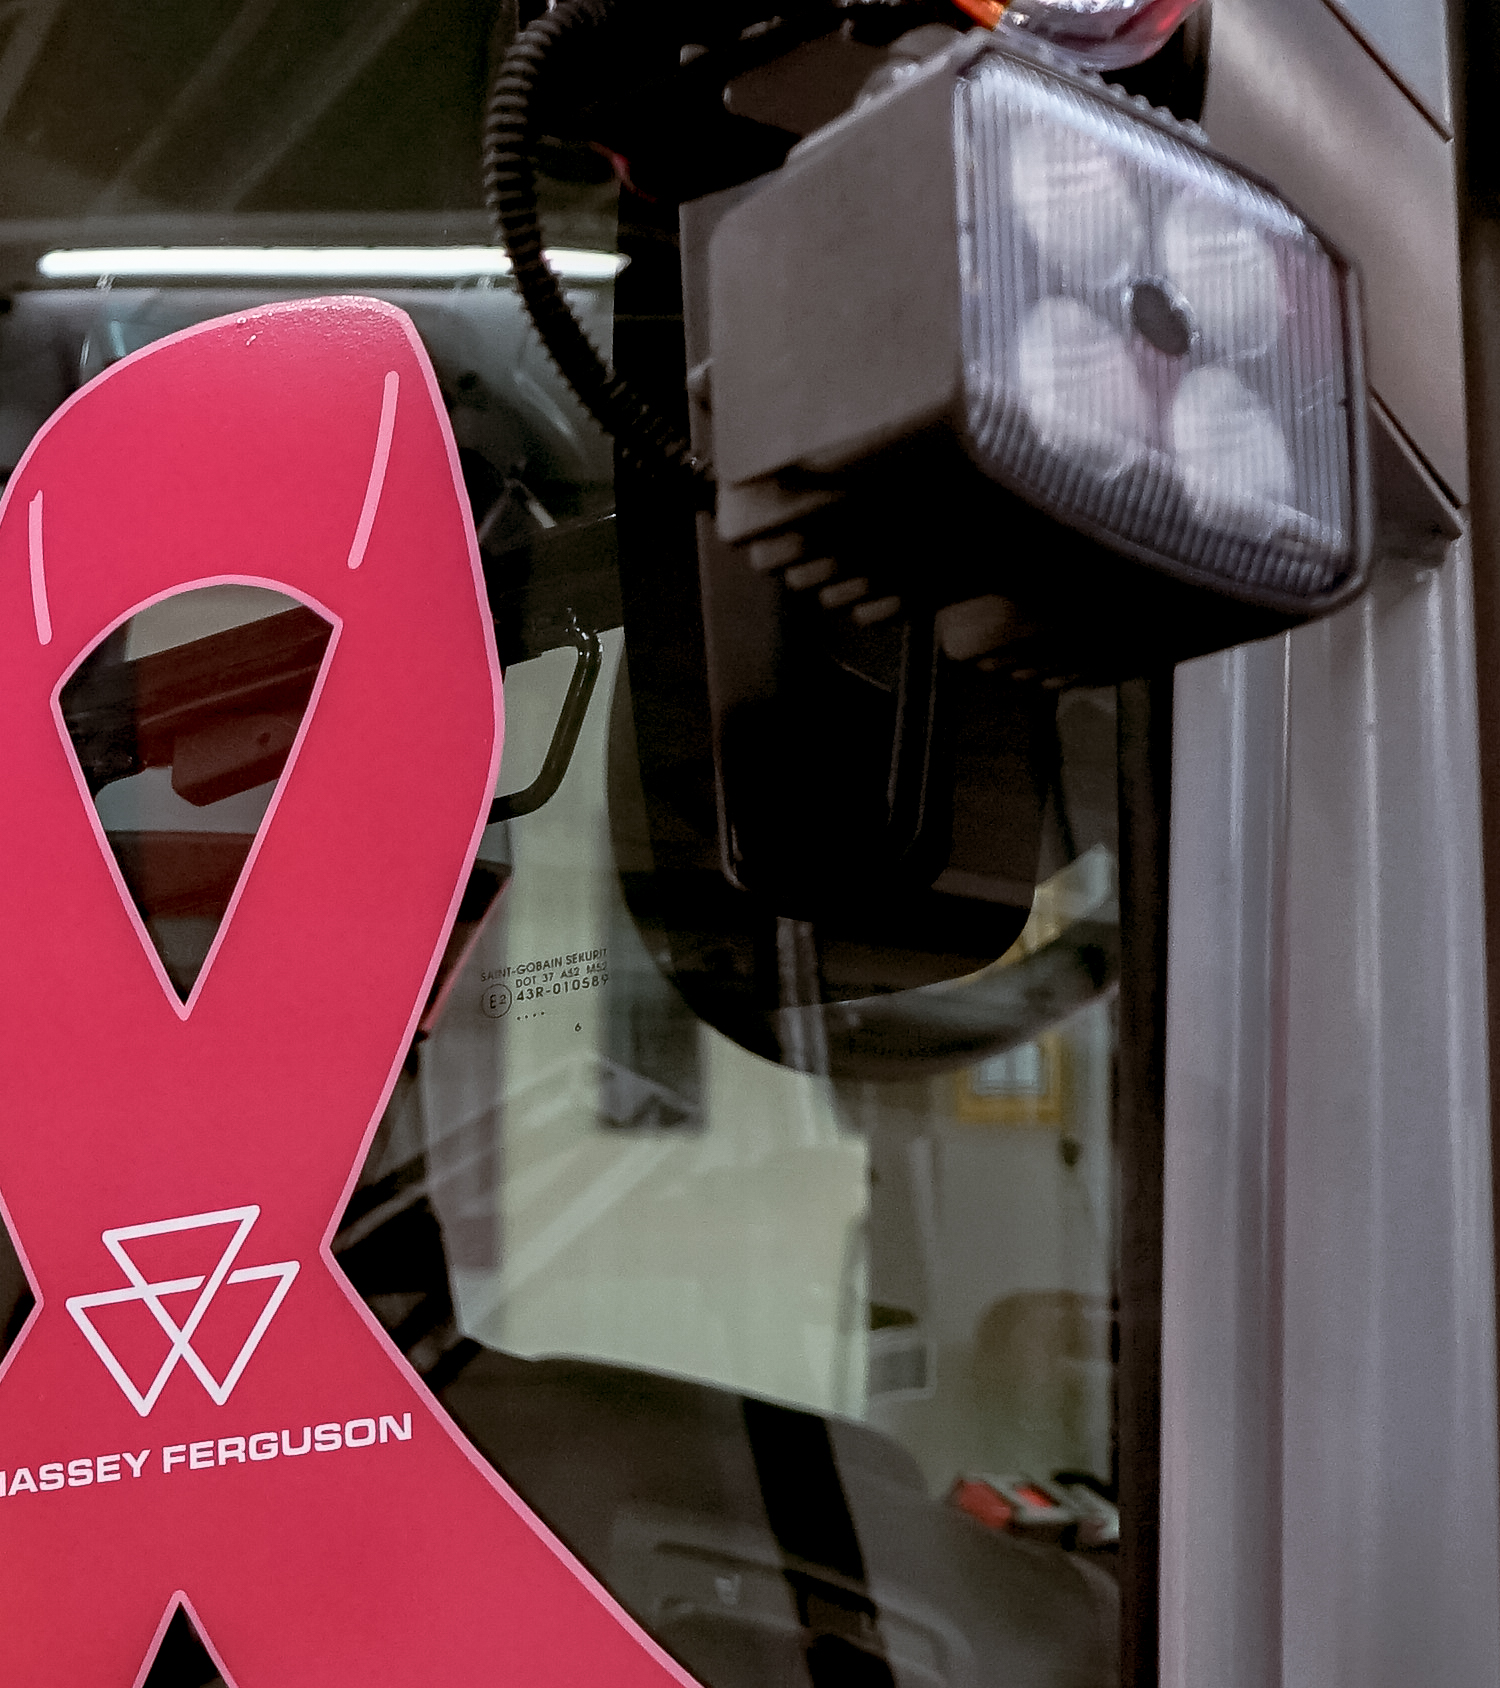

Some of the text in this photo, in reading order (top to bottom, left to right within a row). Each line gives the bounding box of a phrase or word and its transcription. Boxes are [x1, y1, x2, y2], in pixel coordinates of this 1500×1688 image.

[515, 975, 537, 989] DOT
[541, 972, 554, 983] 37
[162, 1412, 413, 1474] FERGUSON
